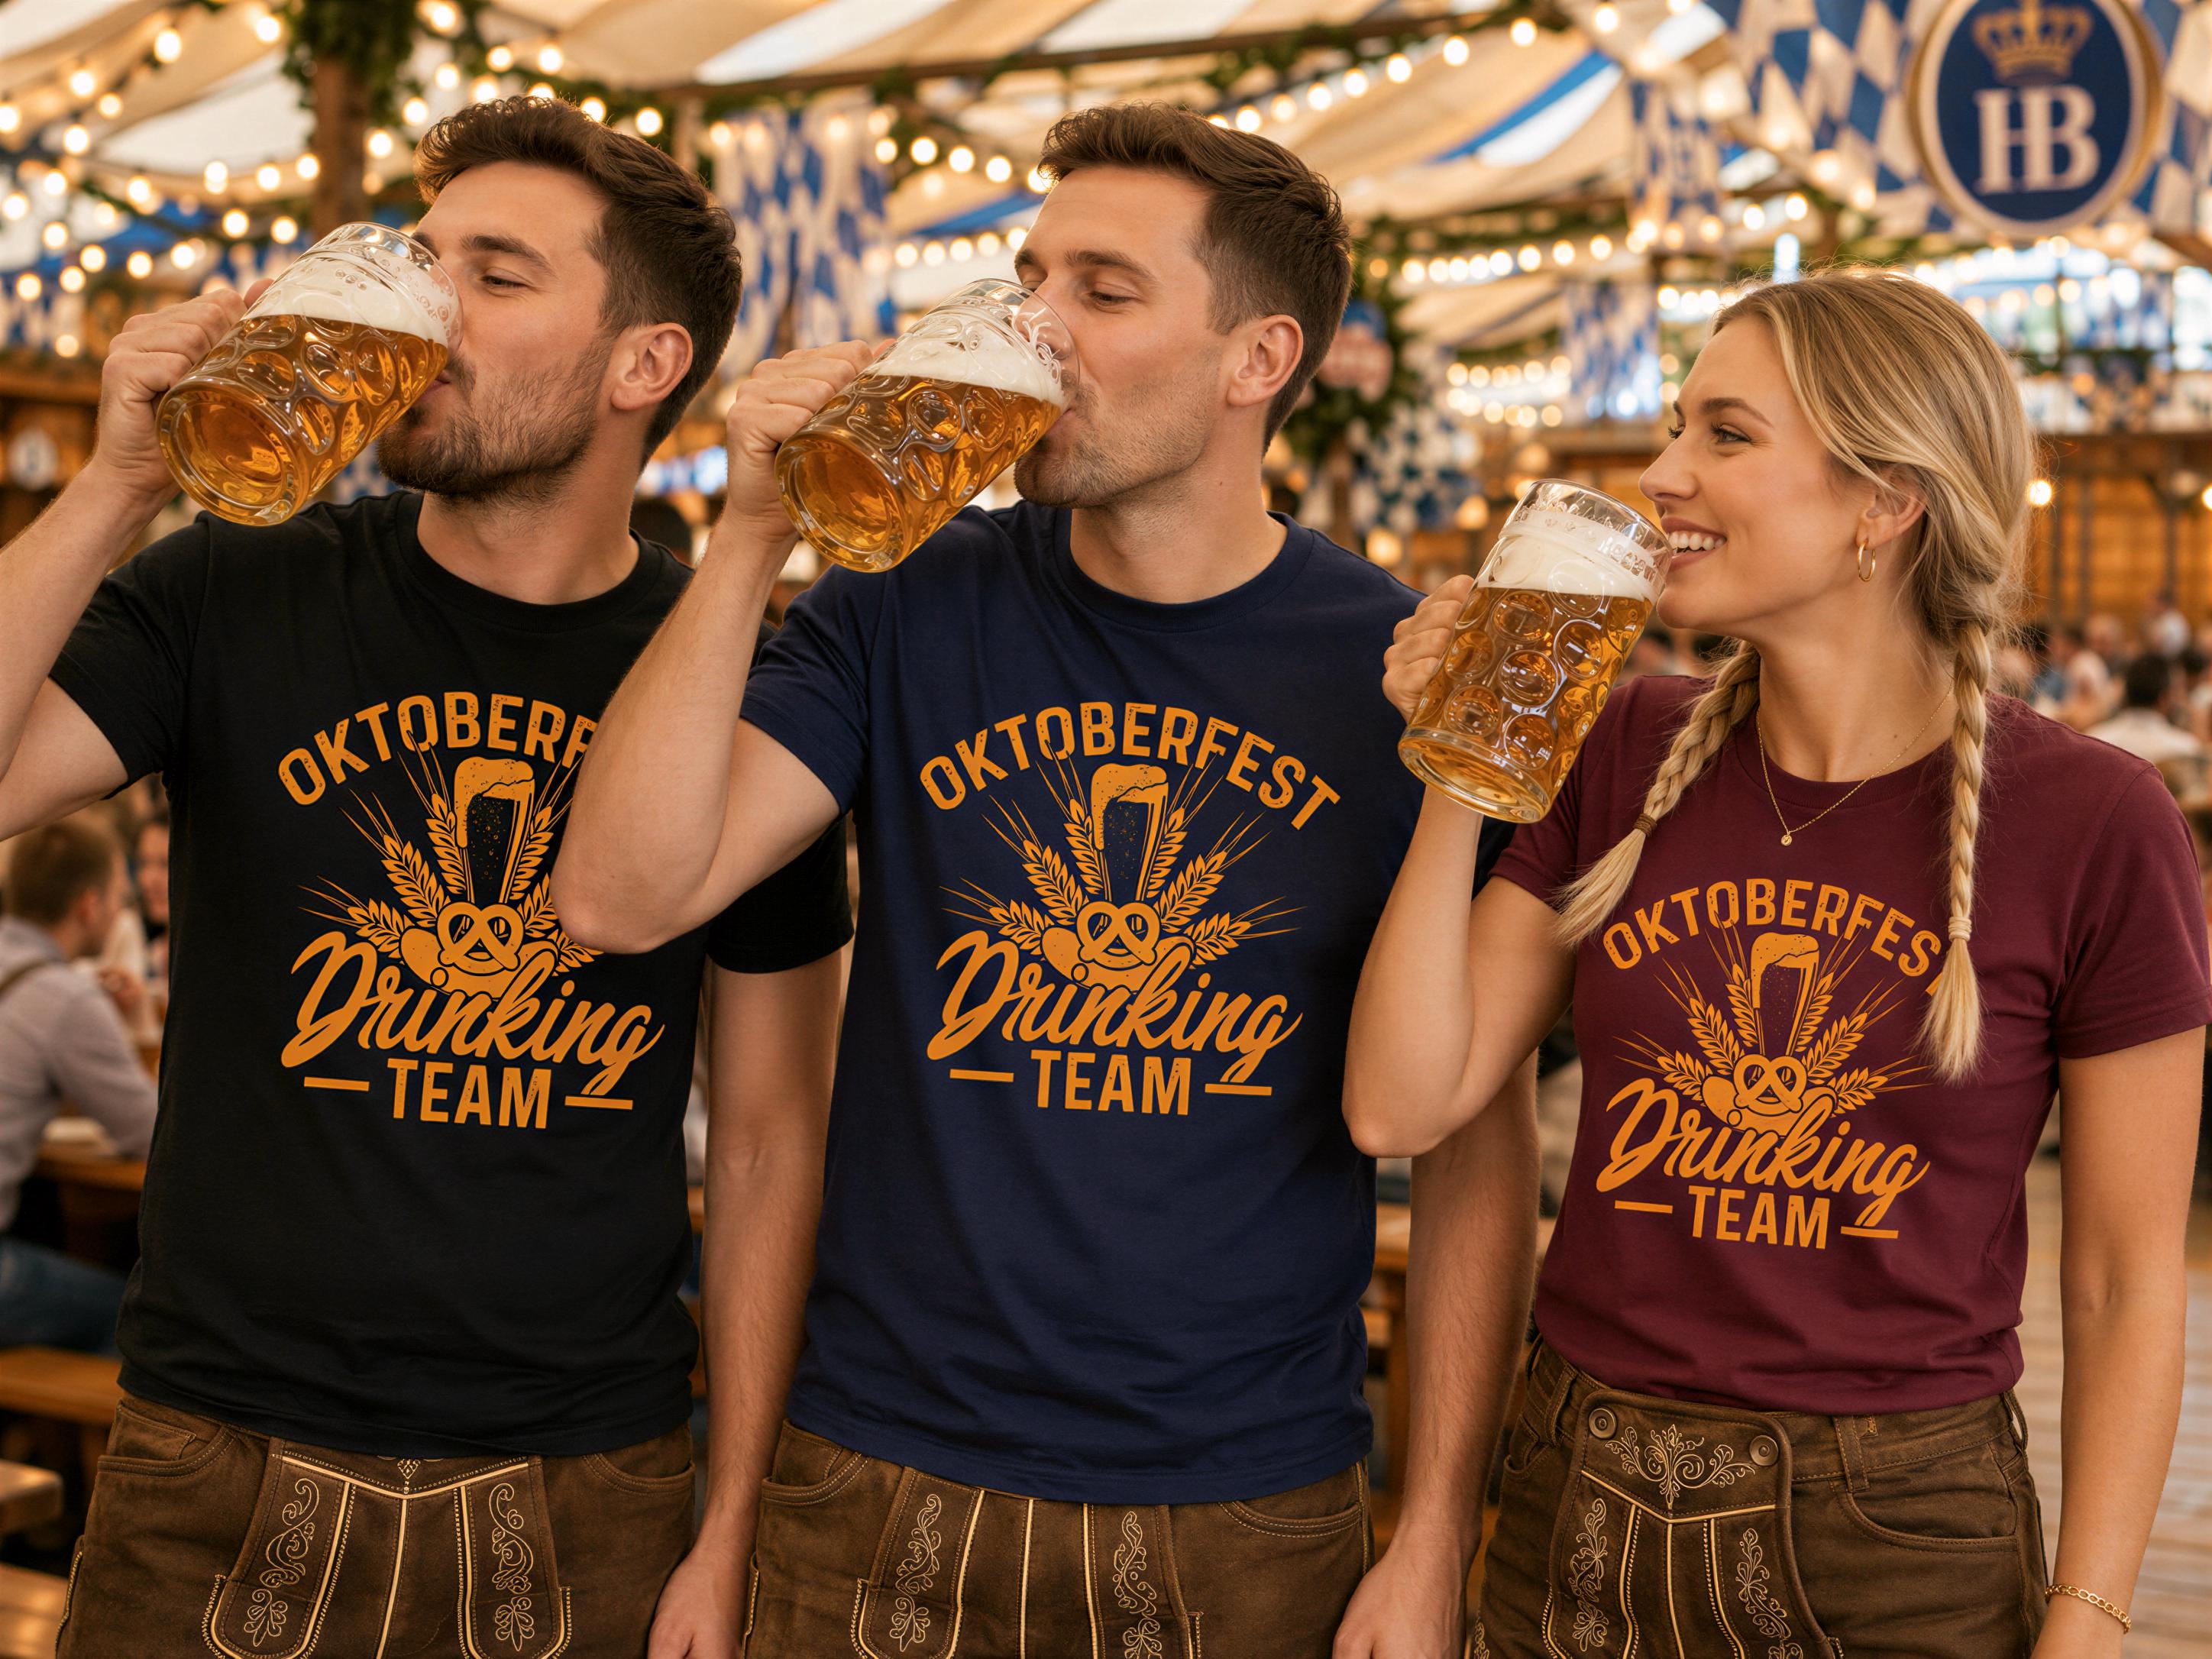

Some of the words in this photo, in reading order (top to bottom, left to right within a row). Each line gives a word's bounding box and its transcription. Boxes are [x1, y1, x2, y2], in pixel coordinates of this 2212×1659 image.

[1974, 83, 2102, 195] HB
[919, 700, 1342, 831] OKTOBERFEST
[1602, 878, 1943, 996] OKTOBERFES
[280, 930, 666, 1097] Drinking
[926, 929, 1304, 1084] Drinking
[386, 1057, 553, 1130] TEAM
[1029, 1048, 1193, 1117] TEAM
[1595, 1076, 1932, 1228] Drinking
[1686, 1183, 1832, 1250] TEAM
